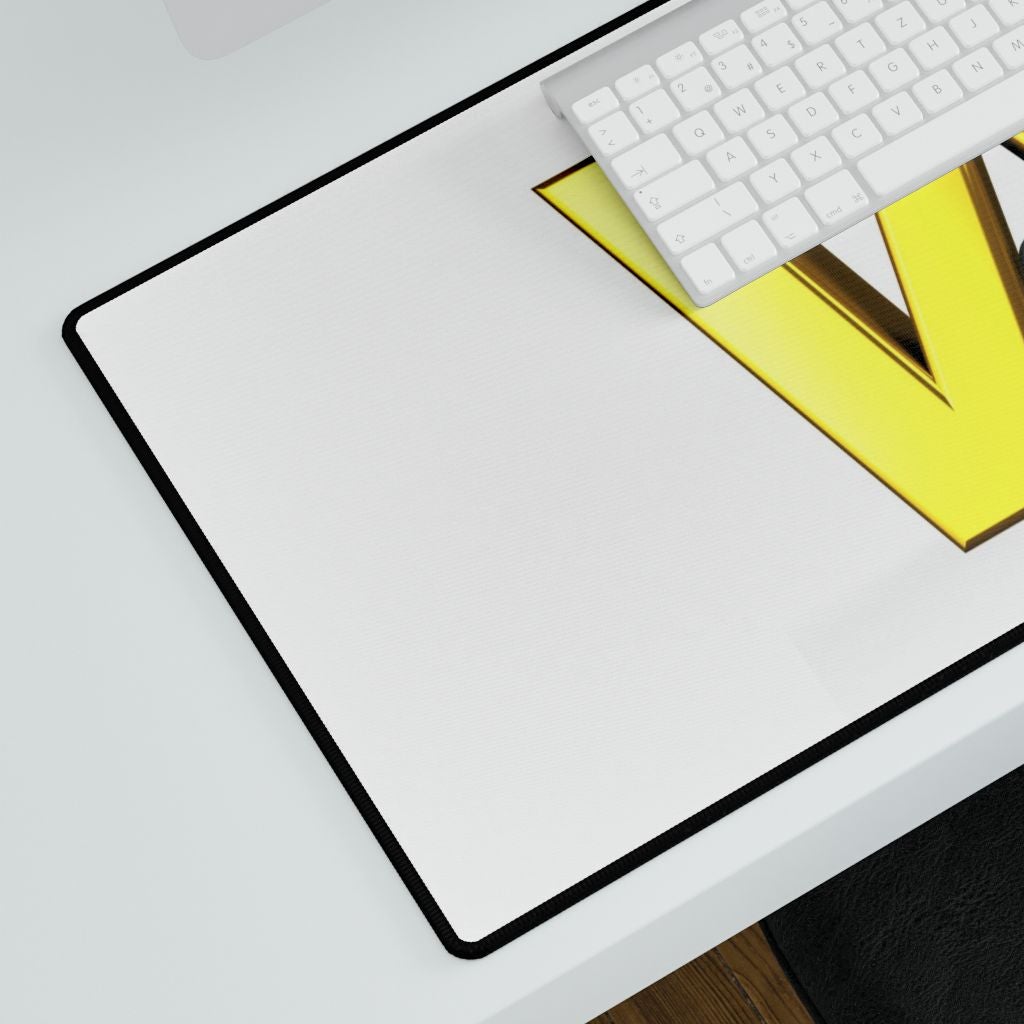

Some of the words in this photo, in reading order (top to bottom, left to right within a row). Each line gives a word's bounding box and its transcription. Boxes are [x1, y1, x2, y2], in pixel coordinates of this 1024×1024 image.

[635, 105, 644, 115] 1
[677, 82, 687, 94] 2
[717, 60, 728, 73] 3
[760, 38, 768, 48] 4
[799, 16, 808, 27] 5
[693, 127, 706, 138] Q
[732, 104, 747, 117] W
[775, 82, 787, 94] E
[816, 61, 827, 72] R
[855, 39, 866, 49] T
[896, 16, 908, 29] Z
[726, 151, 737, 164] A
[765, 128, 776, 140] S
[805, 106, 817, 119] D
[847, 83, 856, 95] F
[887, 61, 899, 73] G
[926, 39, 939, 51] H
[969, 17, 977, 29] J
[768, 172, 779, 184] Y
[809, 149, 822, 162] X
[851, 127, 863, 139] C
[890, 105, 901, 116] V
[931, 84, 943, 95] B
[971, 61, 985, 73] N
[1011, 39, 1024, 52] M
[826, 205, 843, 219] cmd
